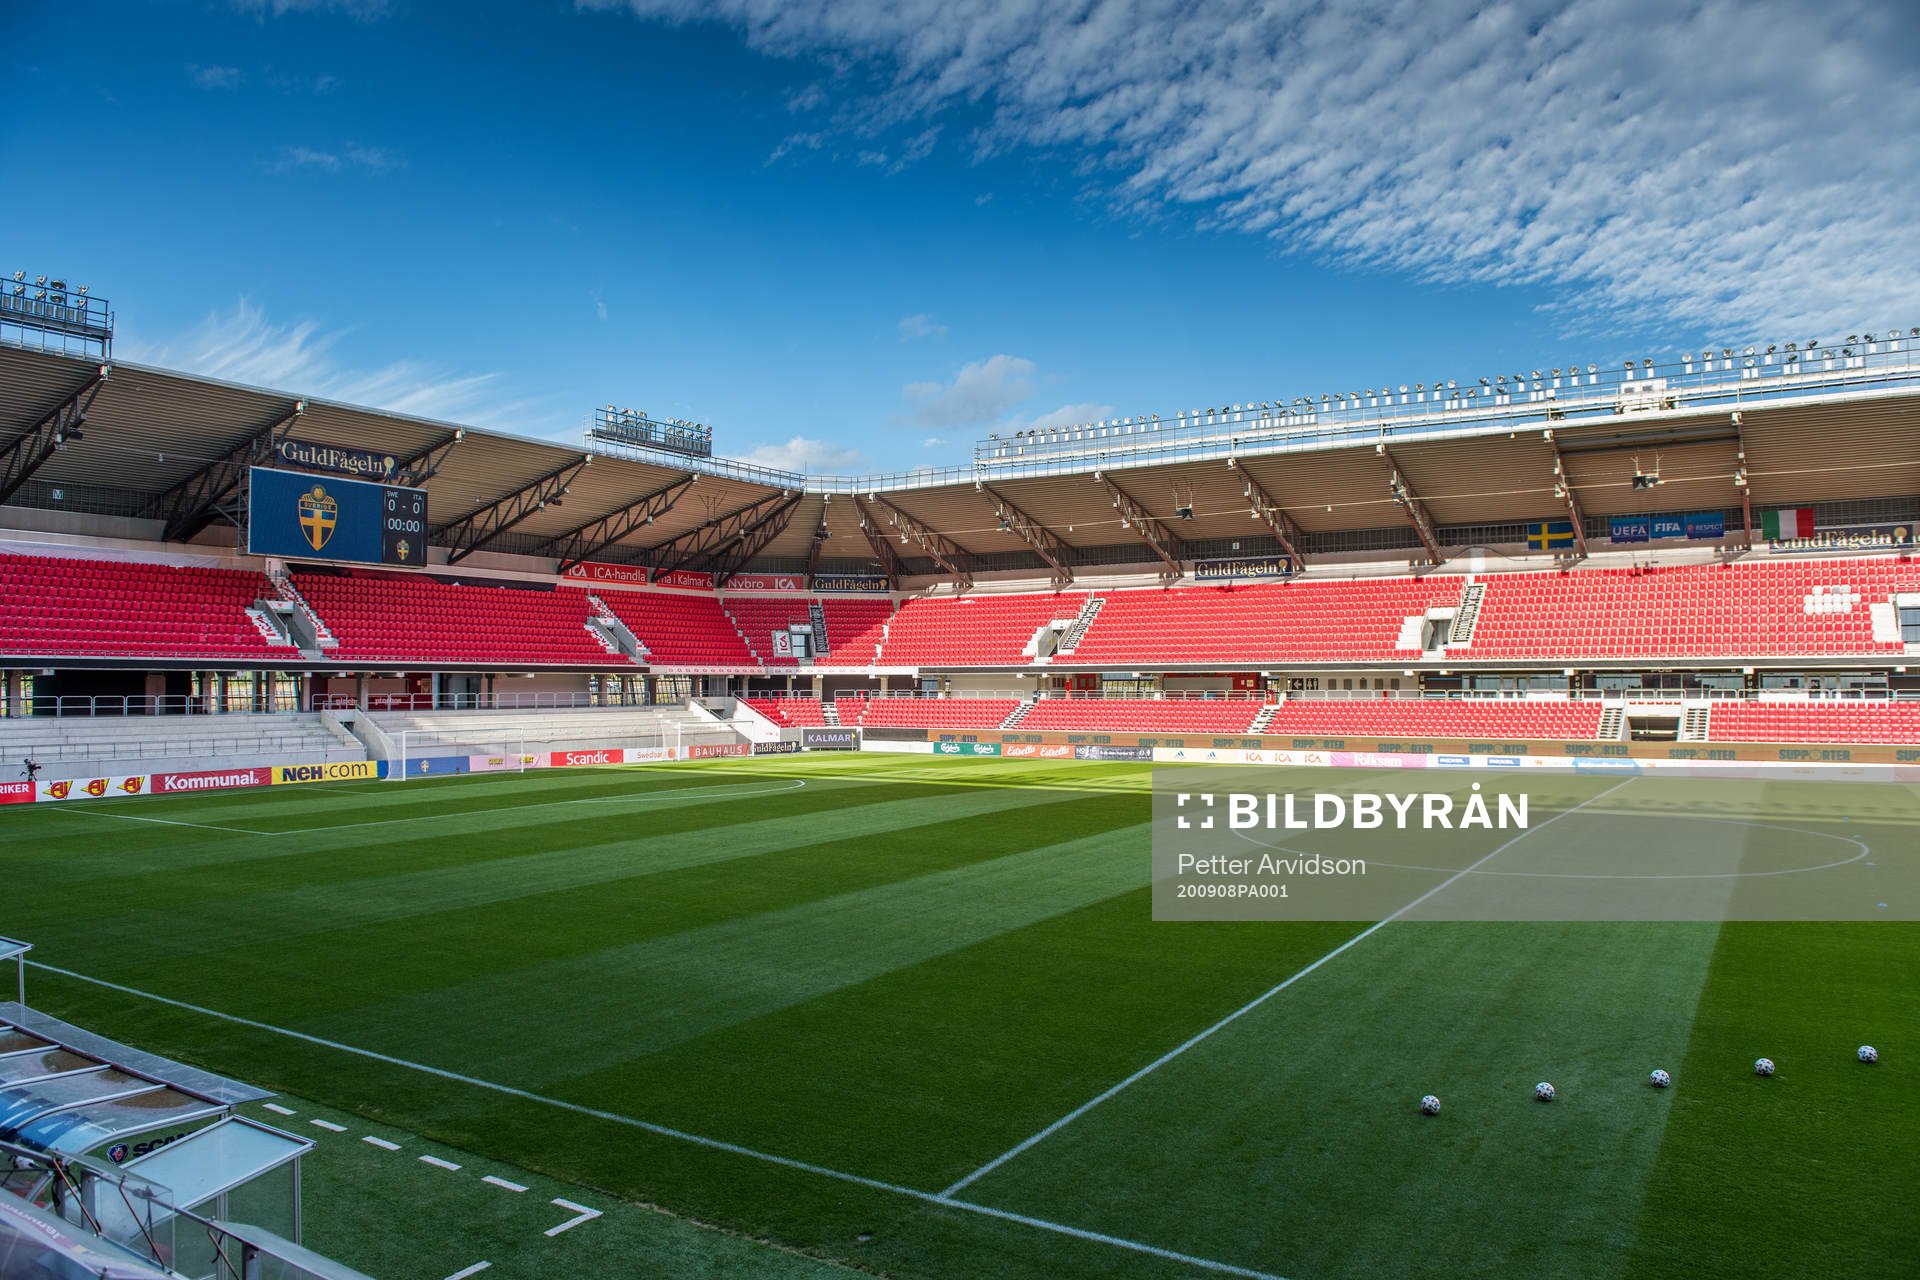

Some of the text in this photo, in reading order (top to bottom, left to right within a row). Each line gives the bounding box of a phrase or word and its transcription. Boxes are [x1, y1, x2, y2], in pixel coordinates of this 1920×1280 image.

[281, 441, 383, 474] GuldFågeln
[388, 499, 396, 511] 0
[412, 502, 420, 513] 0
[388, 518, 420, 532] 00:00
[1612, 526, 1646, 536] UEFA
[1655, 522, 1681, 532] FIFA
[1695, 523, 1722, 531] RESPECT
[568, 564, 646, 582] ICA ICA-handla
[1197, 560, 1277, 577] GuldFågeln
[677, 575, 706, 587] Kalmar
[706, 577, 713, 587] &
[728, 579, 796, 589] Nybro ICA
[815, 579, 879, 590] GuldFågeln
[808, 734, 850, 742] KALMAR
[695, 745, 743, 757] BAUHAUS
[1007, 745, 1035, 755] Estrella
[1040, 745, 1069, 756] Estrella
[566, 751, 609, 765] Scandic
[1246, 752, 1321, 763] ICA ICA ICA
[1354, 753, 1402, 767] Folksam
